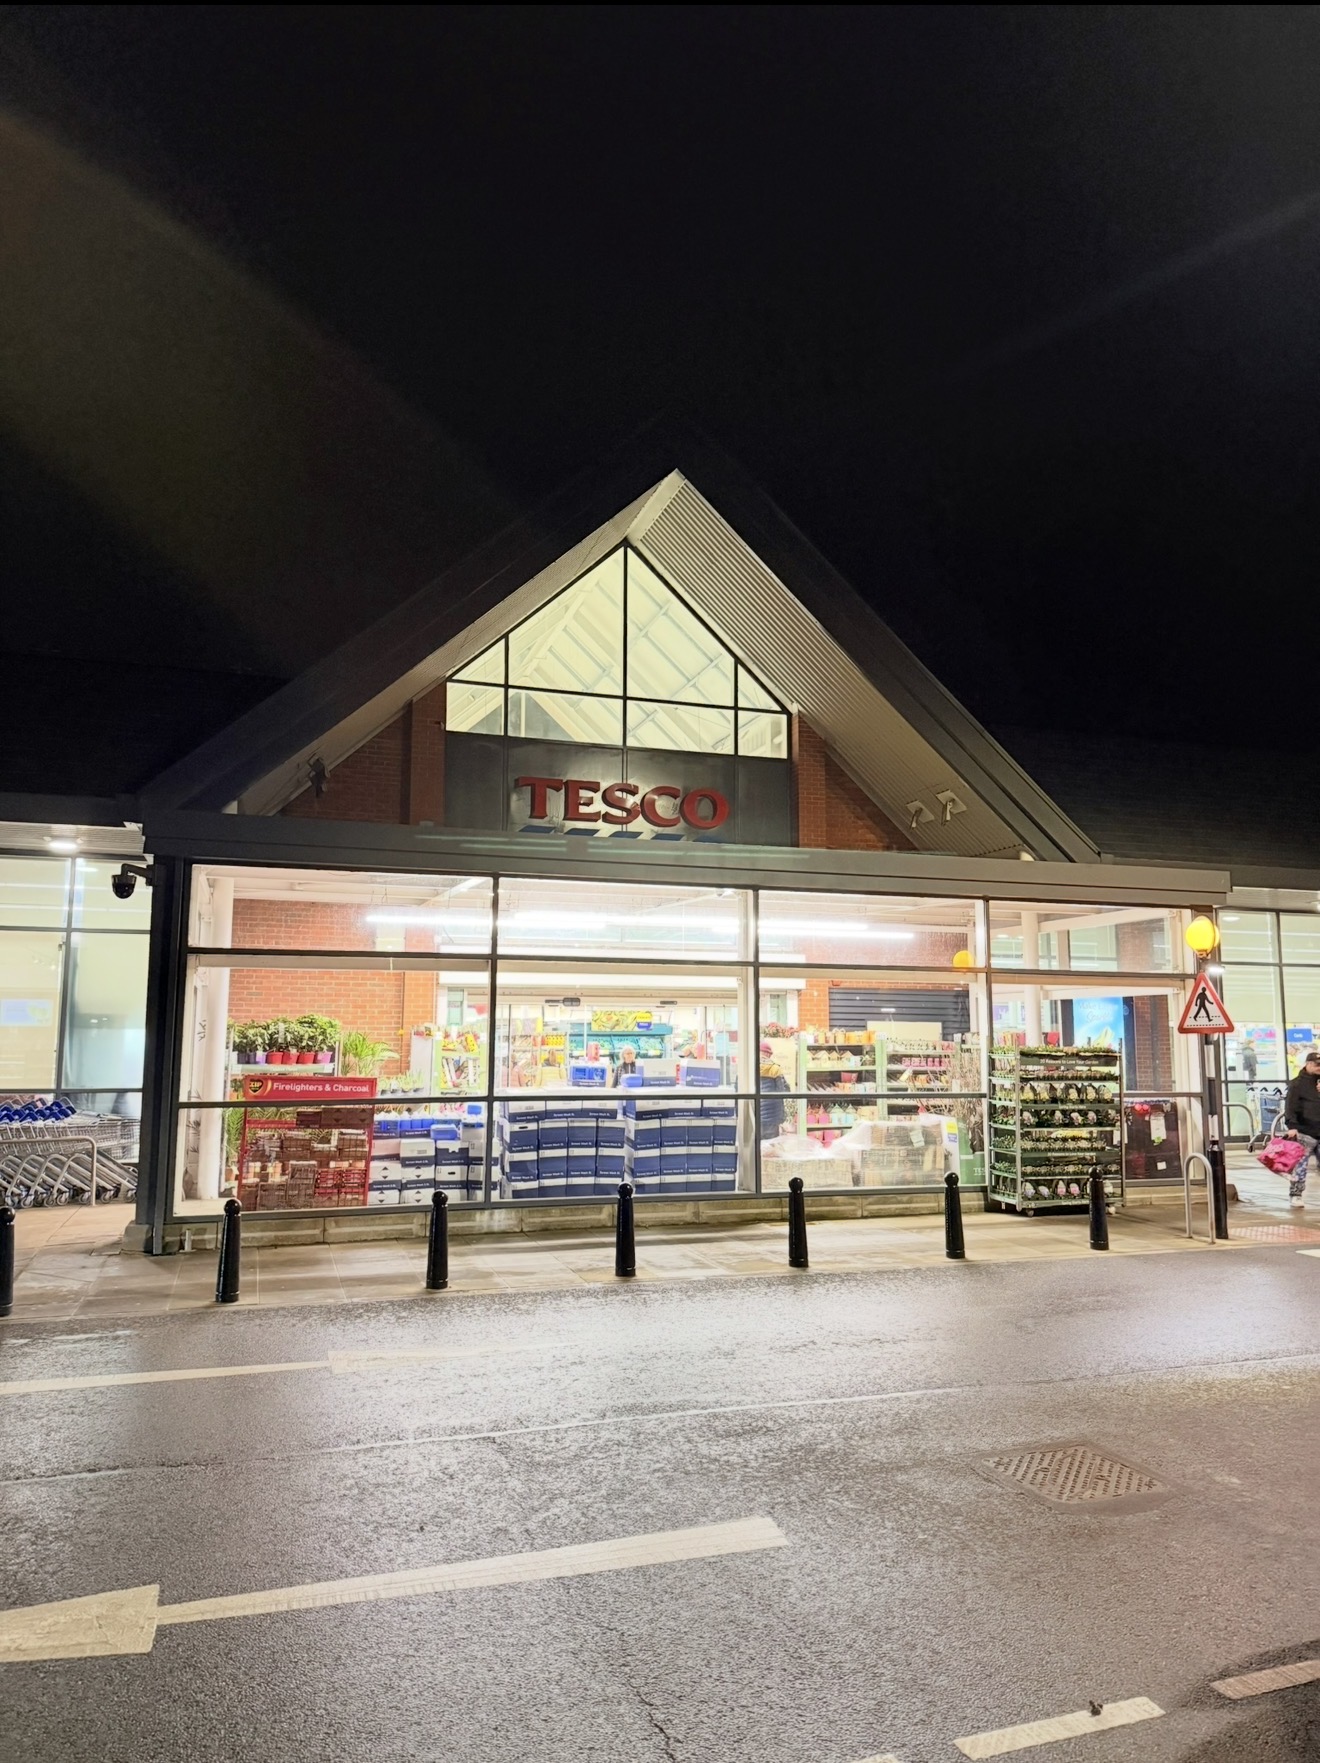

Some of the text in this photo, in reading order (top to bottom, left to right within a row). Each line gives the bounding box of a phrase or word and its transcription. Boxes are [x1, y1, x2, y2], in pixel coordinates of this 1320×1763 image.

[514, 776, 730, 830] TESCO
[273, 1082, 369, 1092] Firelighters & Charcoal
